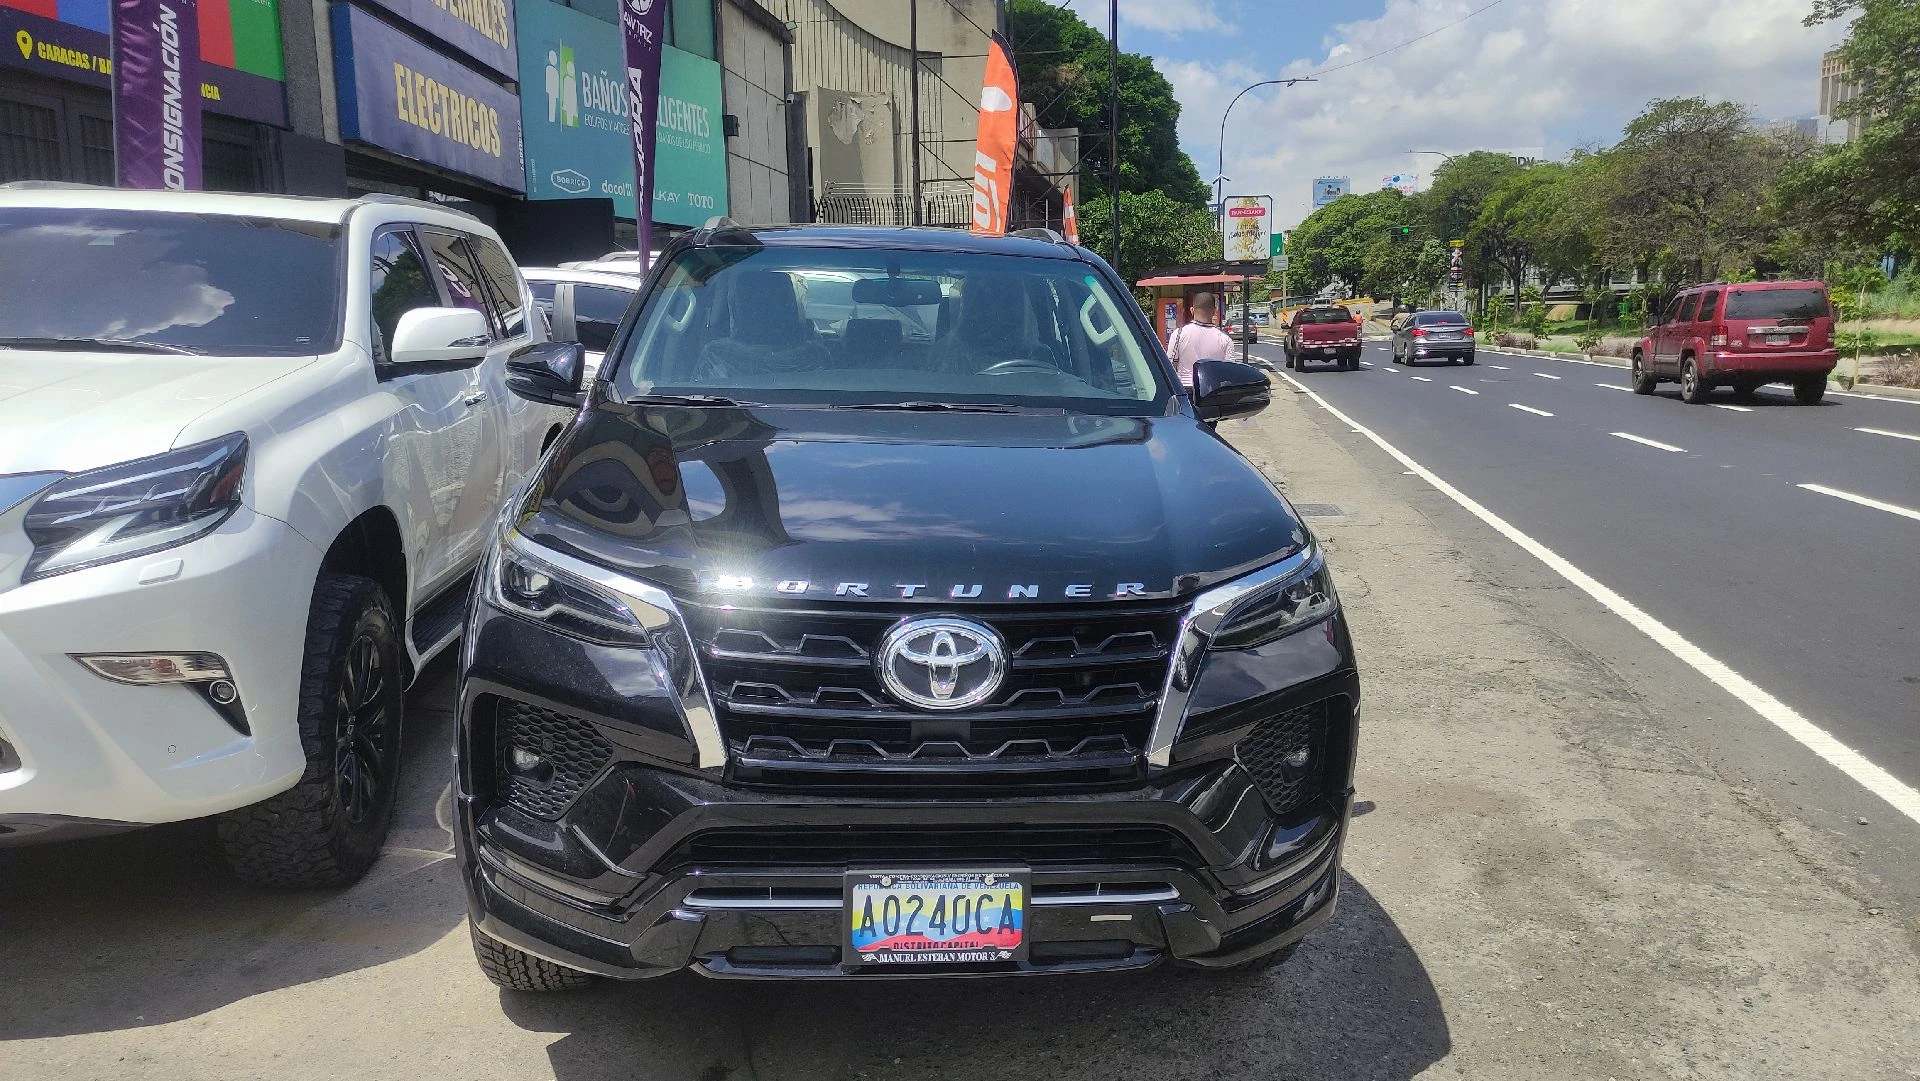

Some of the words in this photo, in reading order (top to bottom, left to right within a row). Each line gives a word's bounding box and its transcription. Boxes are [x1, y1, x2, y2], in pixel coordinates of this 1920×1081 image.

[37, 41, 90, 70] CARACAS
[154, 3, 185, 190] ONSIGNACIÓN
[394, 62, 501, 158] ELECTRICOS
[581, 70, 629, 117] BAÑOS
[656, 95, 710, 138] LIGENTES
[556, 174, 586, 187] BOBRICK
[653, 189, 681, 203] LKAY
[687, 192, 714, 209] TOTO
[961, 882, 972, 890] DE
[878, 952, 917, 963] MANUEL
[917, 952, 957, 962] ESTEBAN
